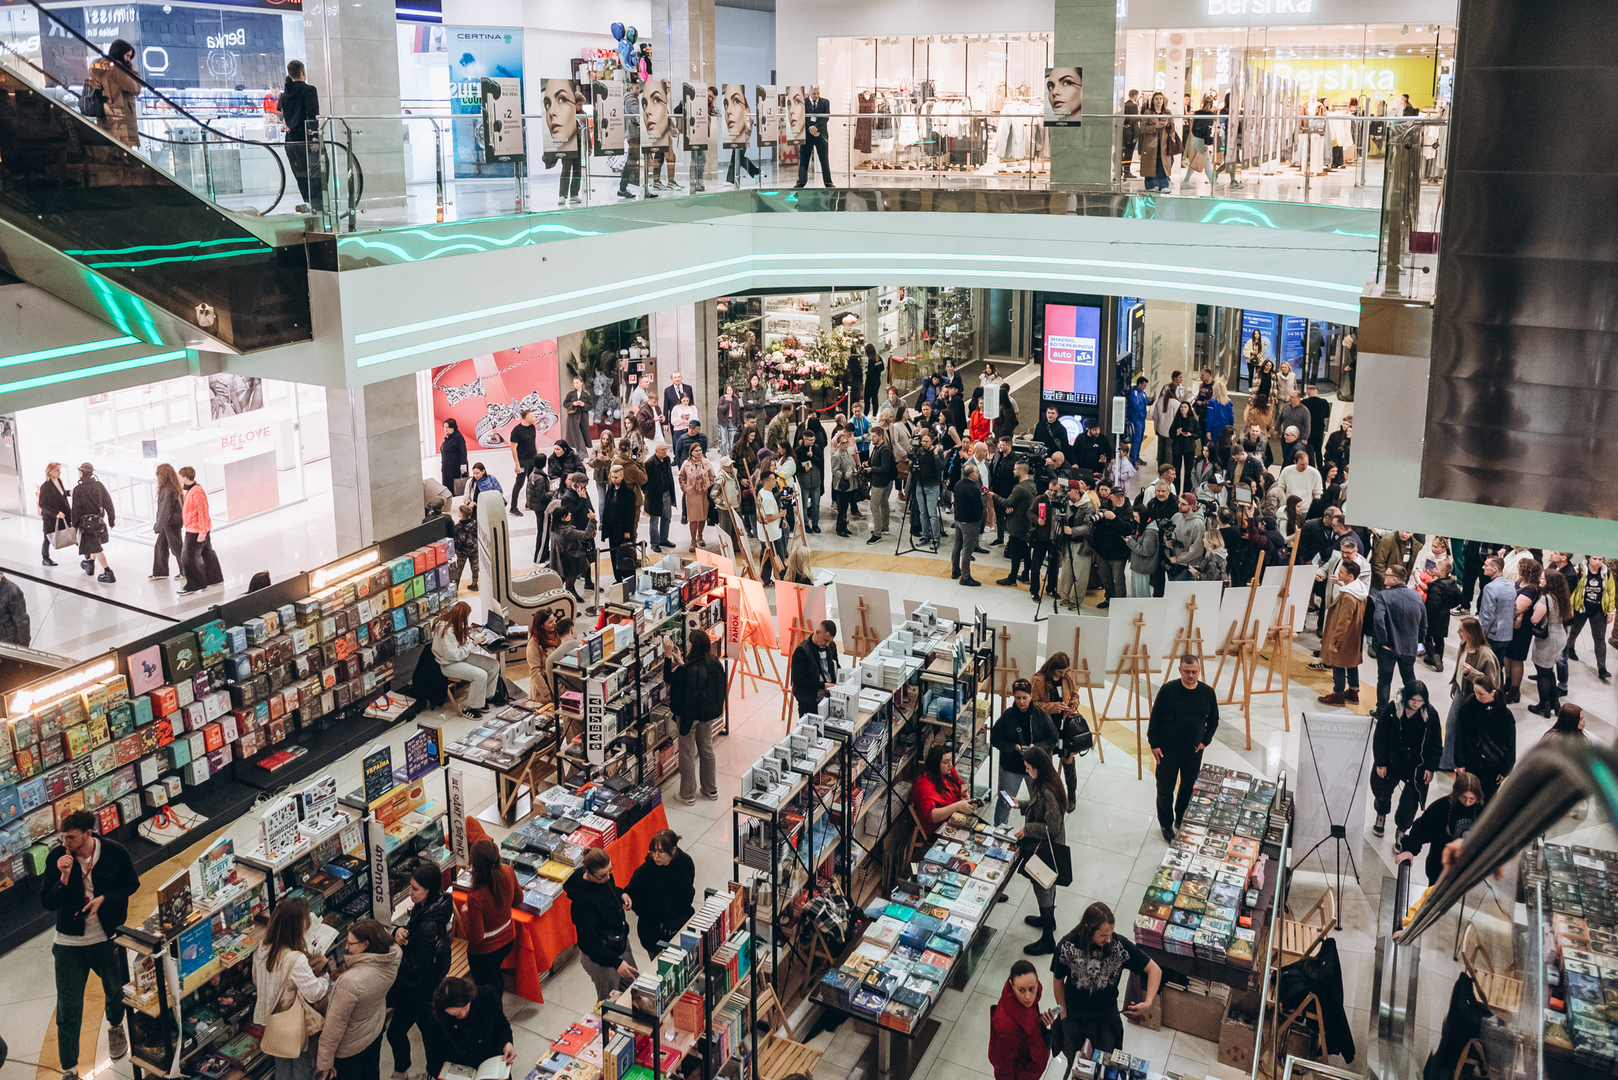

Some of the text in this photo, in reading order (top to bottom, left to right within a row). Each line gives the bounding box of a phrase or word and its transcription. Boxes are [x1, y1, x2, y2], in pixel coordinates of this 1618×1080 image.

[1273, 63, 1395, 91] Bershka
[504, 109, 512, 119] x2
[609, 108, 617, 117] x2
[696, 108, 702, 116] x2
[1053, 351, 1072, 359] auto
[589, 698, 602, 750] ФАБУЛА
[365, 759, 390, 775] УКРАЇНА
[211, 861, 230, 876] СВІТ
[375, 844, 385, 903] 4mamas
